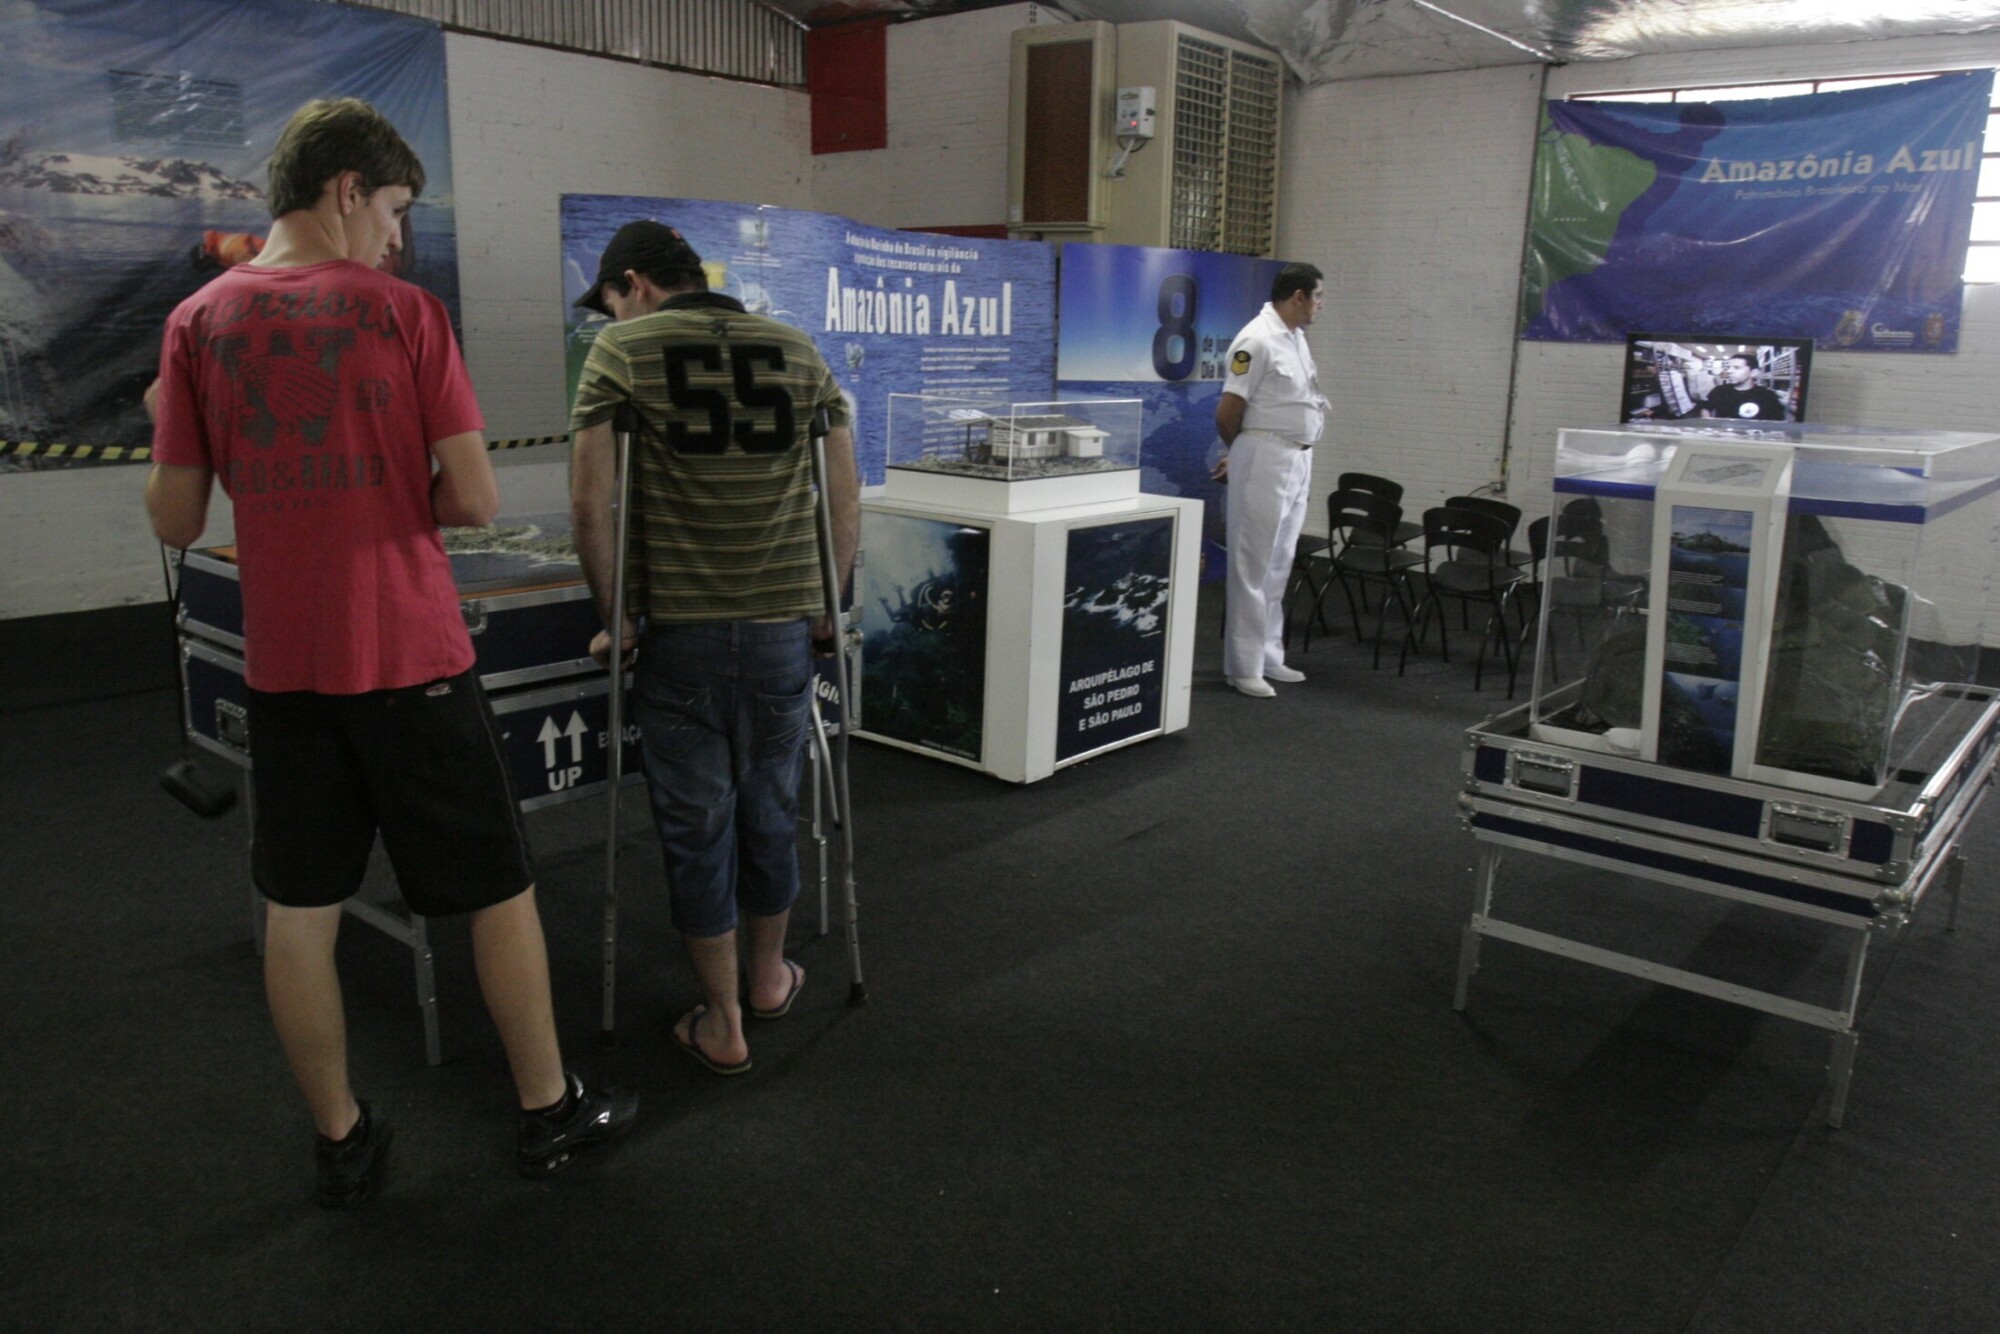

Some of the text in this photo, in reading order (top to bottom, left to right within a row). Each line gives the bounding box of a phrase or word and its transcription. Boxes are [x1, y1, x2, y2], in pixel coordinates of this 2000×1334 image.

[1700, 141, 1977, 184] Amazônia Azul
[825, 267, 1012, 336] Amazônia Azul
[1152, 274, 1197, 382] 8
[663, 345, 797, 455] 55
[1069, 660, 1155, 694] ARQUIPÉLAGO DE
[1083, 683, 1140, 710] SÃO PEDRO
[1078, 702, 1143, 732] E SÃO PAULO
[547, 766, 583, 793] UP
